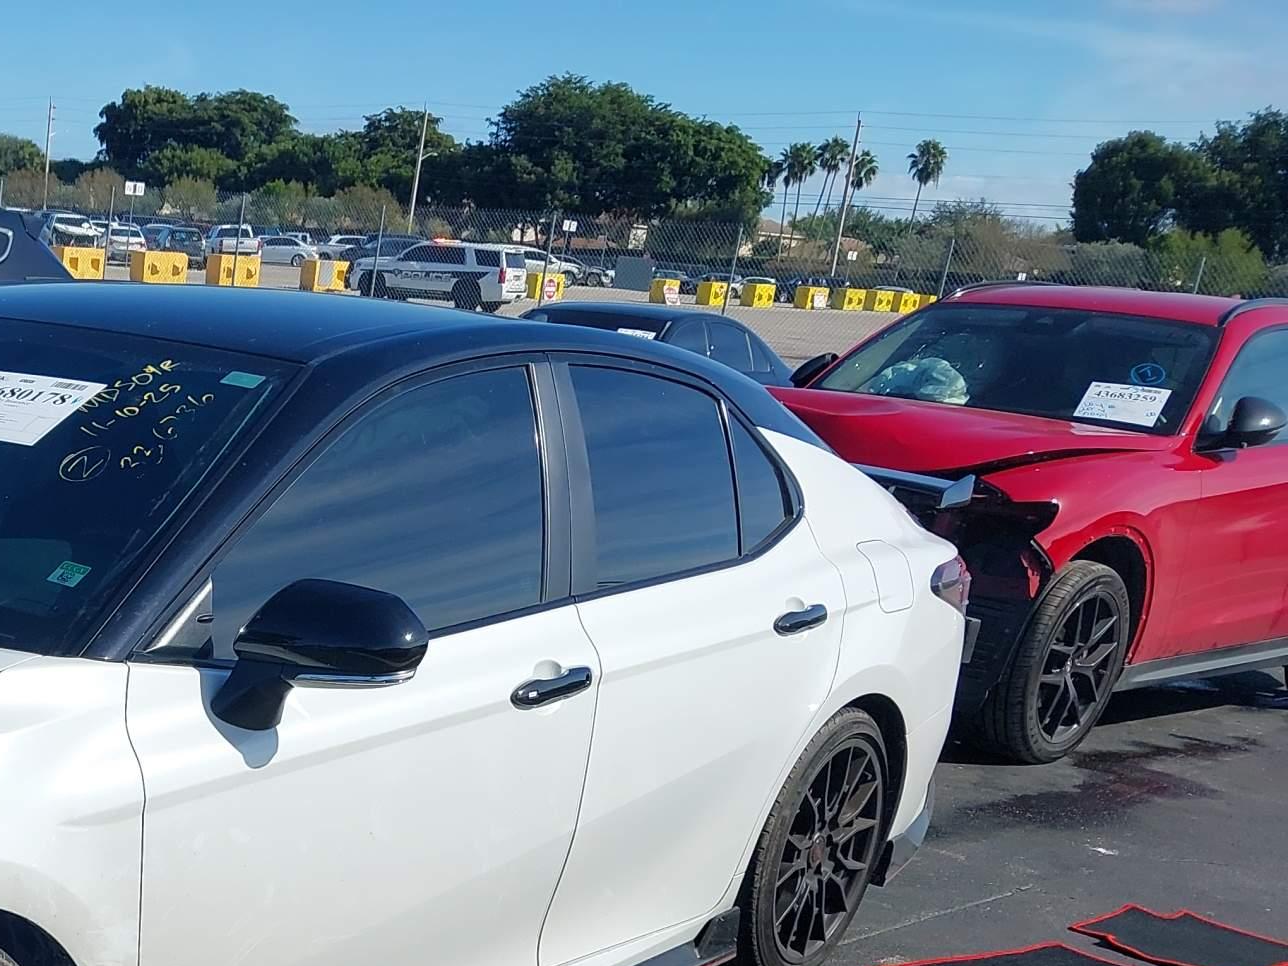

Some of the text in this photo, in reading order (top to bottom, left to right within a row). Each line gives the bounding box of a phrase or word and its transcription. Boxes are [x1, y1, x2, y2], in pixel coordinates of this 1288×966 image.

[401, 270, 452, 282] POLICE
[1094, 390, 1158, 403] 43683259
[80, 383, 181, 437] 11-10-25
